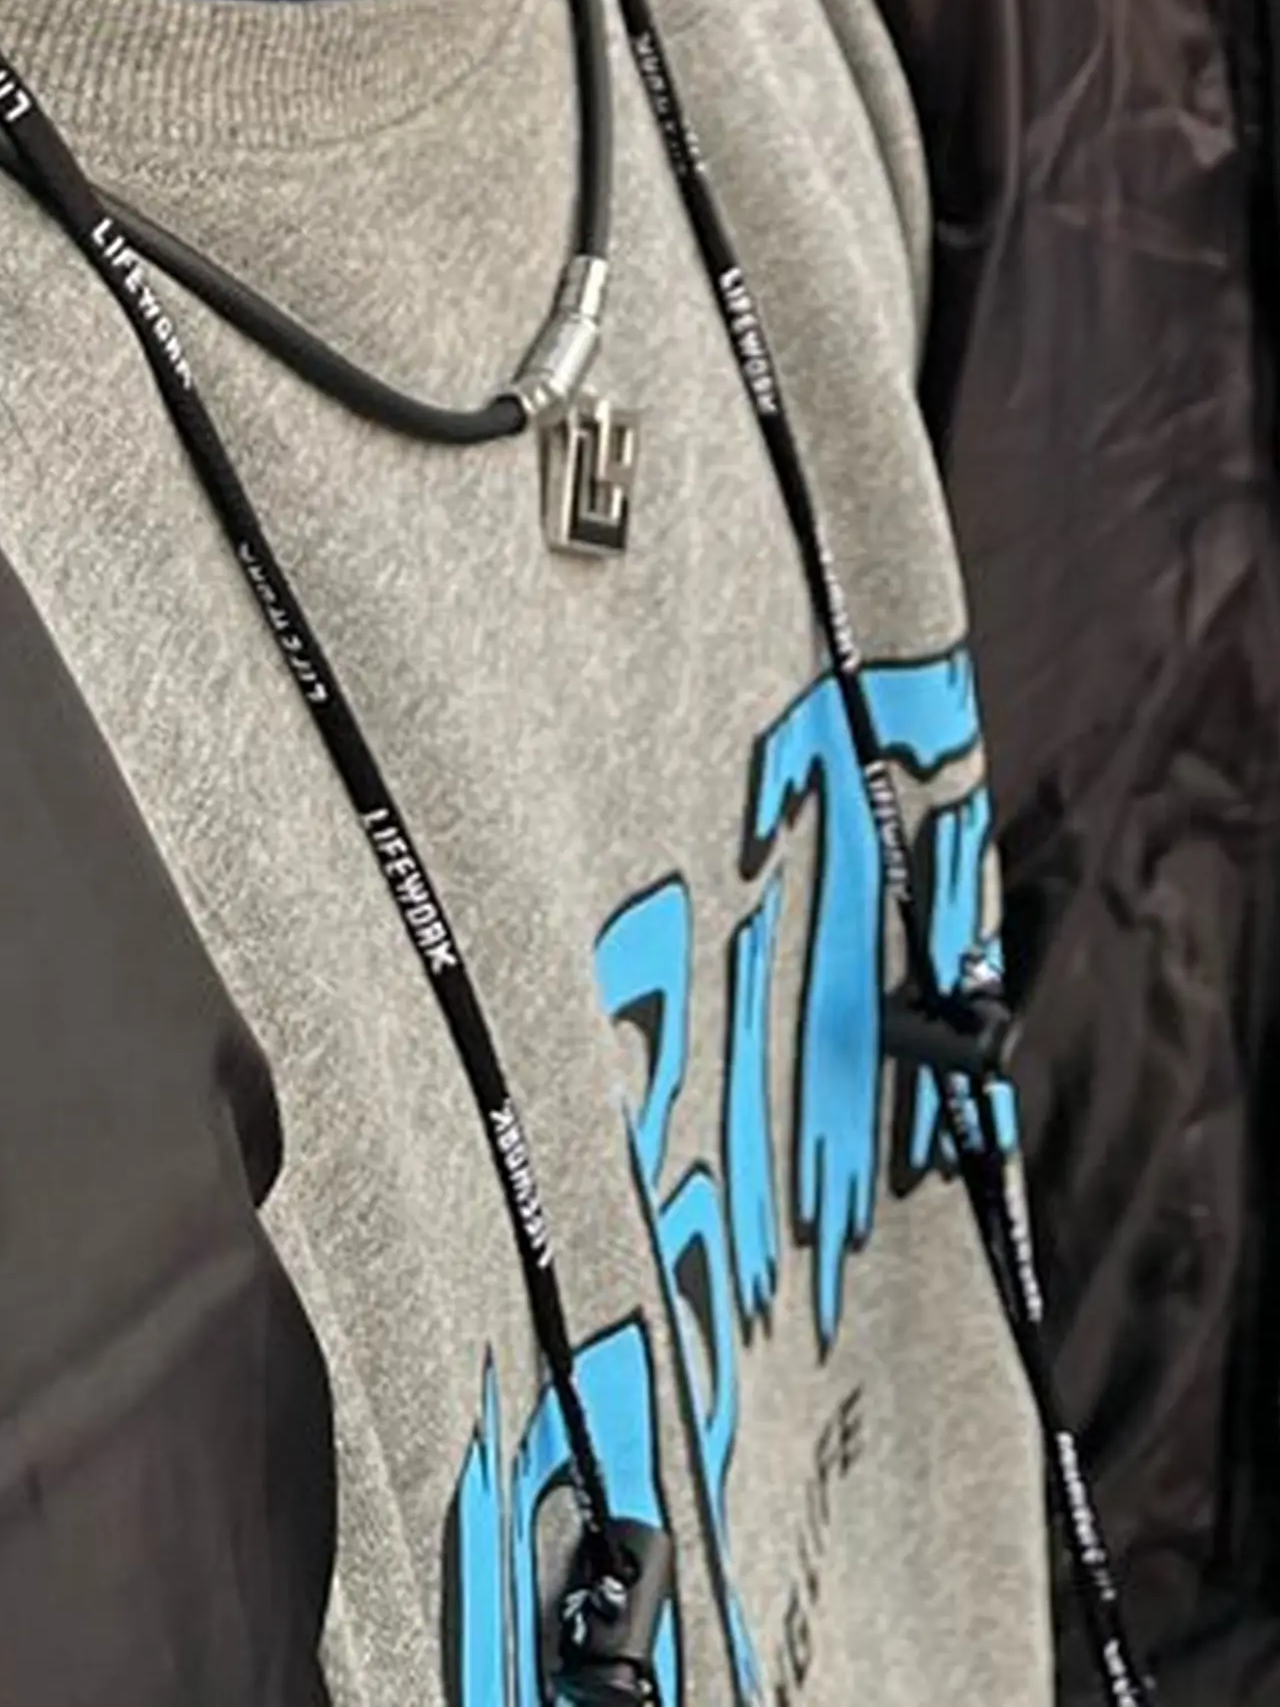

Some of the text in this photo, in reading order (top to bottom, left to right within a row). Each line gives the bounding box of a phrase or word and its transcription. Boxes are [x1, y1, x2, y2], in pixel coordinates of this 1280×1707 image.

[92, 218, 192, 390] LIFEWORK
[721, 267, 777, 414] LIFEWORK
[361, 808, 458, 975] LIFEWORK
[489, 1097, 555, 1270] LIFEWORK
